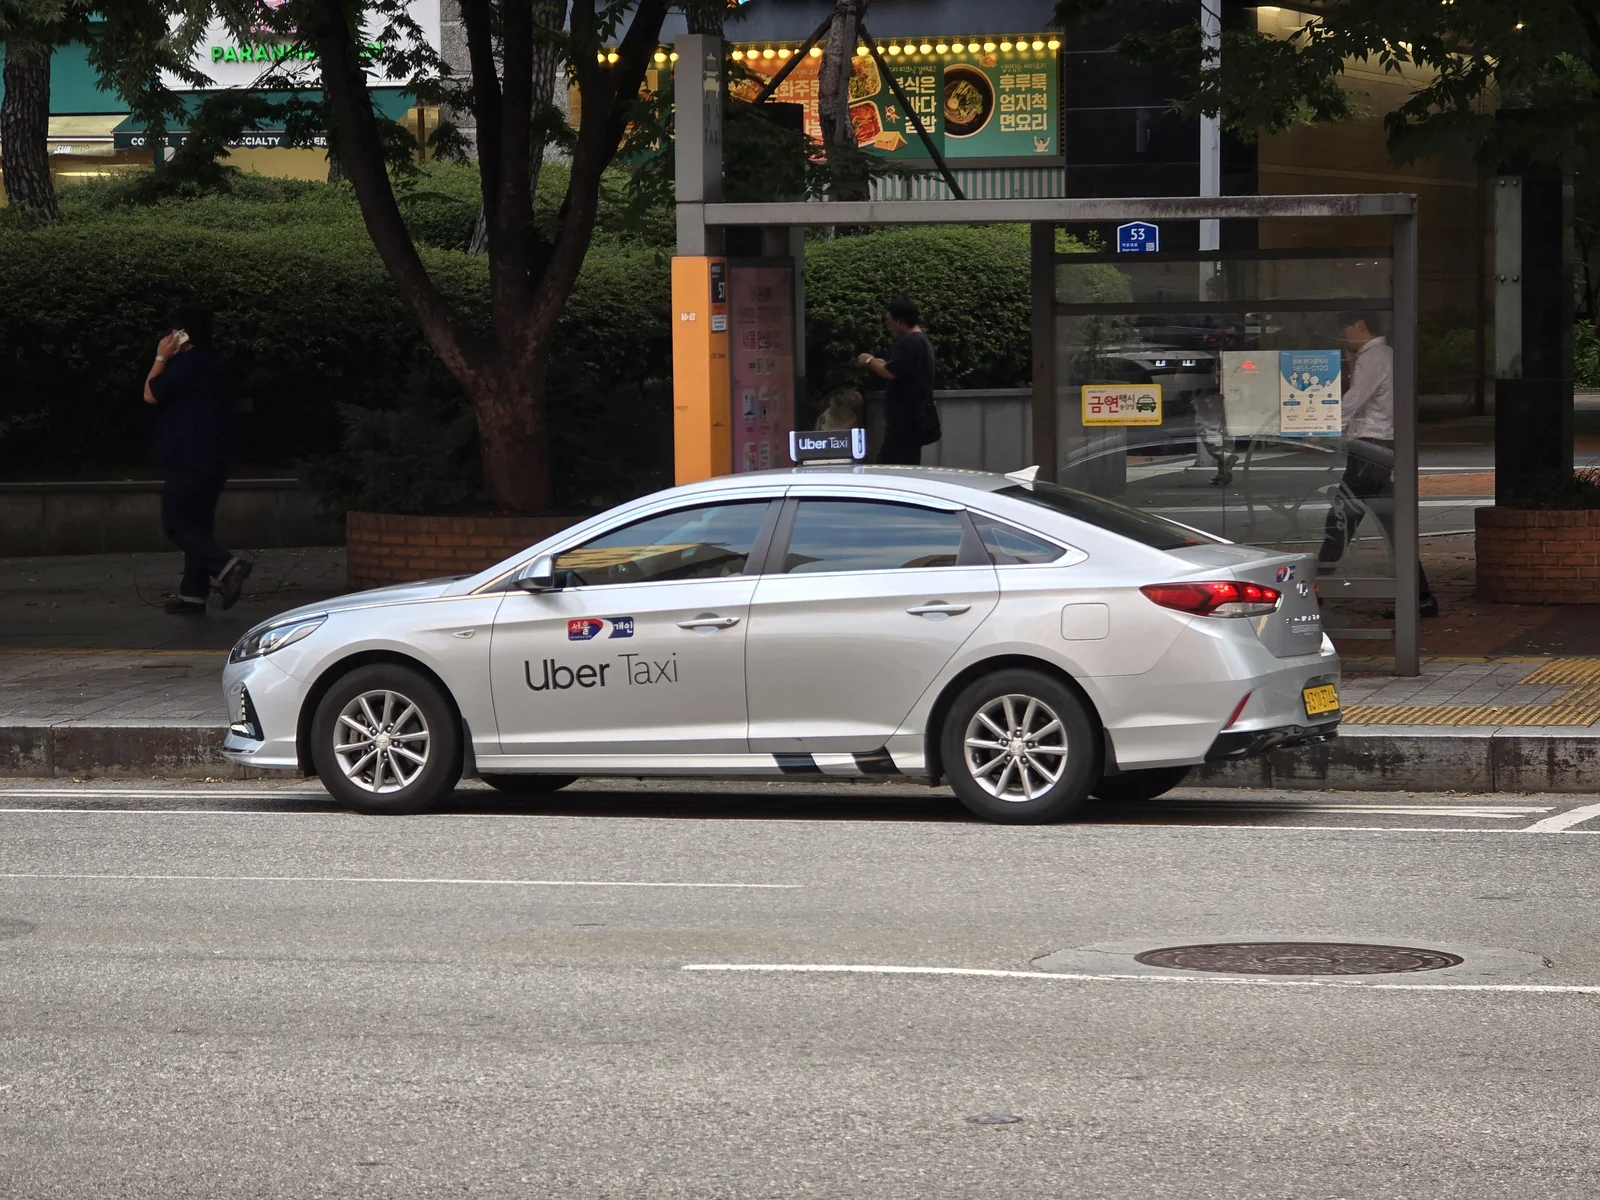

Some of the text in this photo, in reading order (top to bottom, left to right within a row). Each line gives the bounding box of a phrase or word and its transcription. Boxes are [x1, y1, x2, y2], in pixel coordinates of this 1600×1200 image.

[1000, 73, 1047, 91] 후루룩
[1000, 93, 1047, 112] 엄지척
[1000, 113, 1047, 132] 면요리
[1130, 228, 1145, 240] 53
[1088, 395, 1119, 413] 금연
[1119, 394, 1135, 403] 택시
[798, 438, 827, 450] Uber
[828, 437, 848, 449] Taxi
[571, 621, 591, 635] 서울
[614, 621, 633, 634] 개인
[524, 652, 679, 692] Uber Taxi
